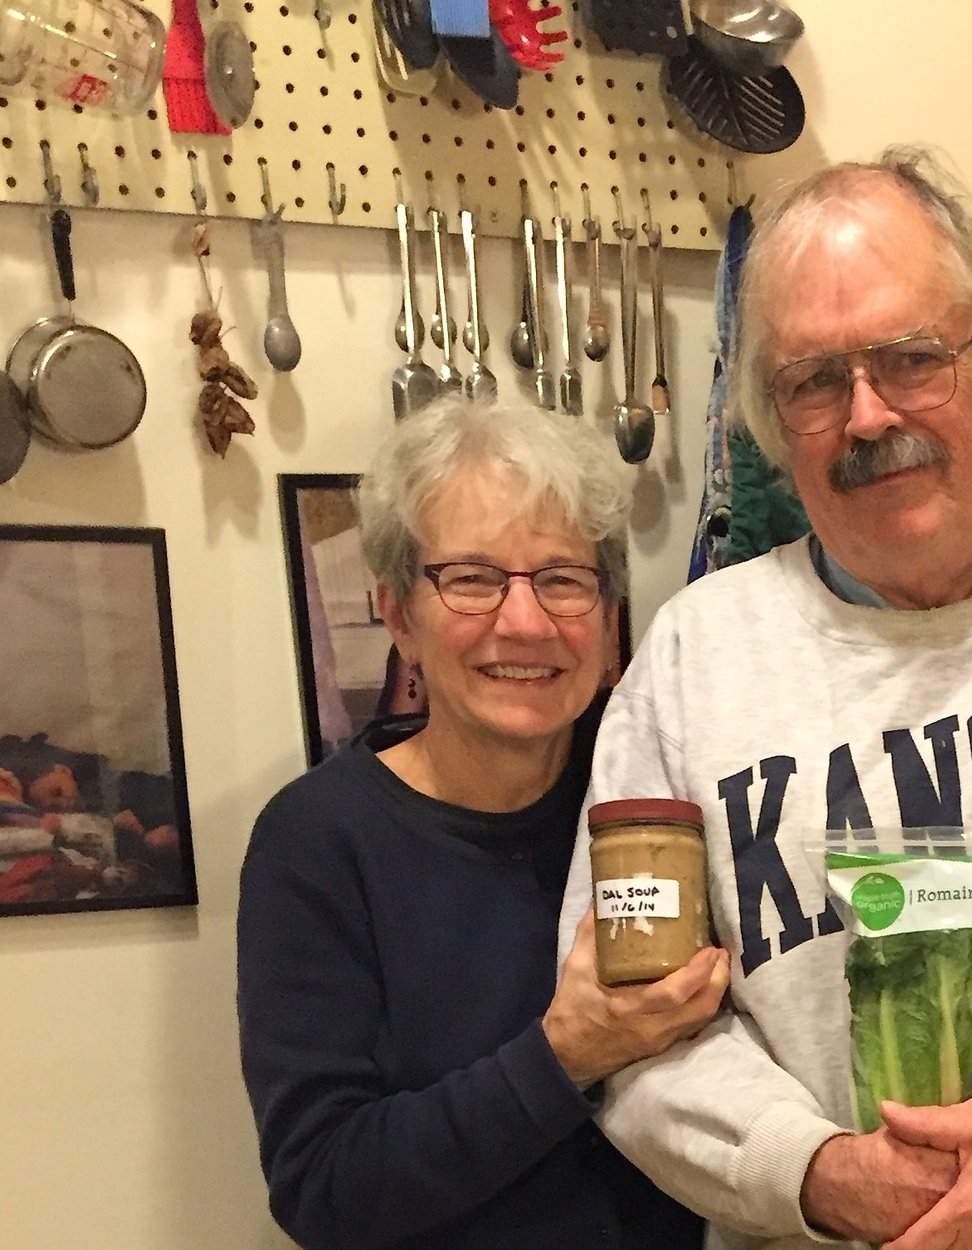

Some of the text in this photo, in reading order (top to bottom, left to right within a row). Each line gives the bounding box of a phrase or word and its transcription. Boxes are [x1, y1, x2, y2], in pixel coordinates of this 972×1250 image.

[602, 886, 660, 900] DAL SOUP
[611, 901, 655, 912] 11/6/14
[855, 899, 902, 913] organic
